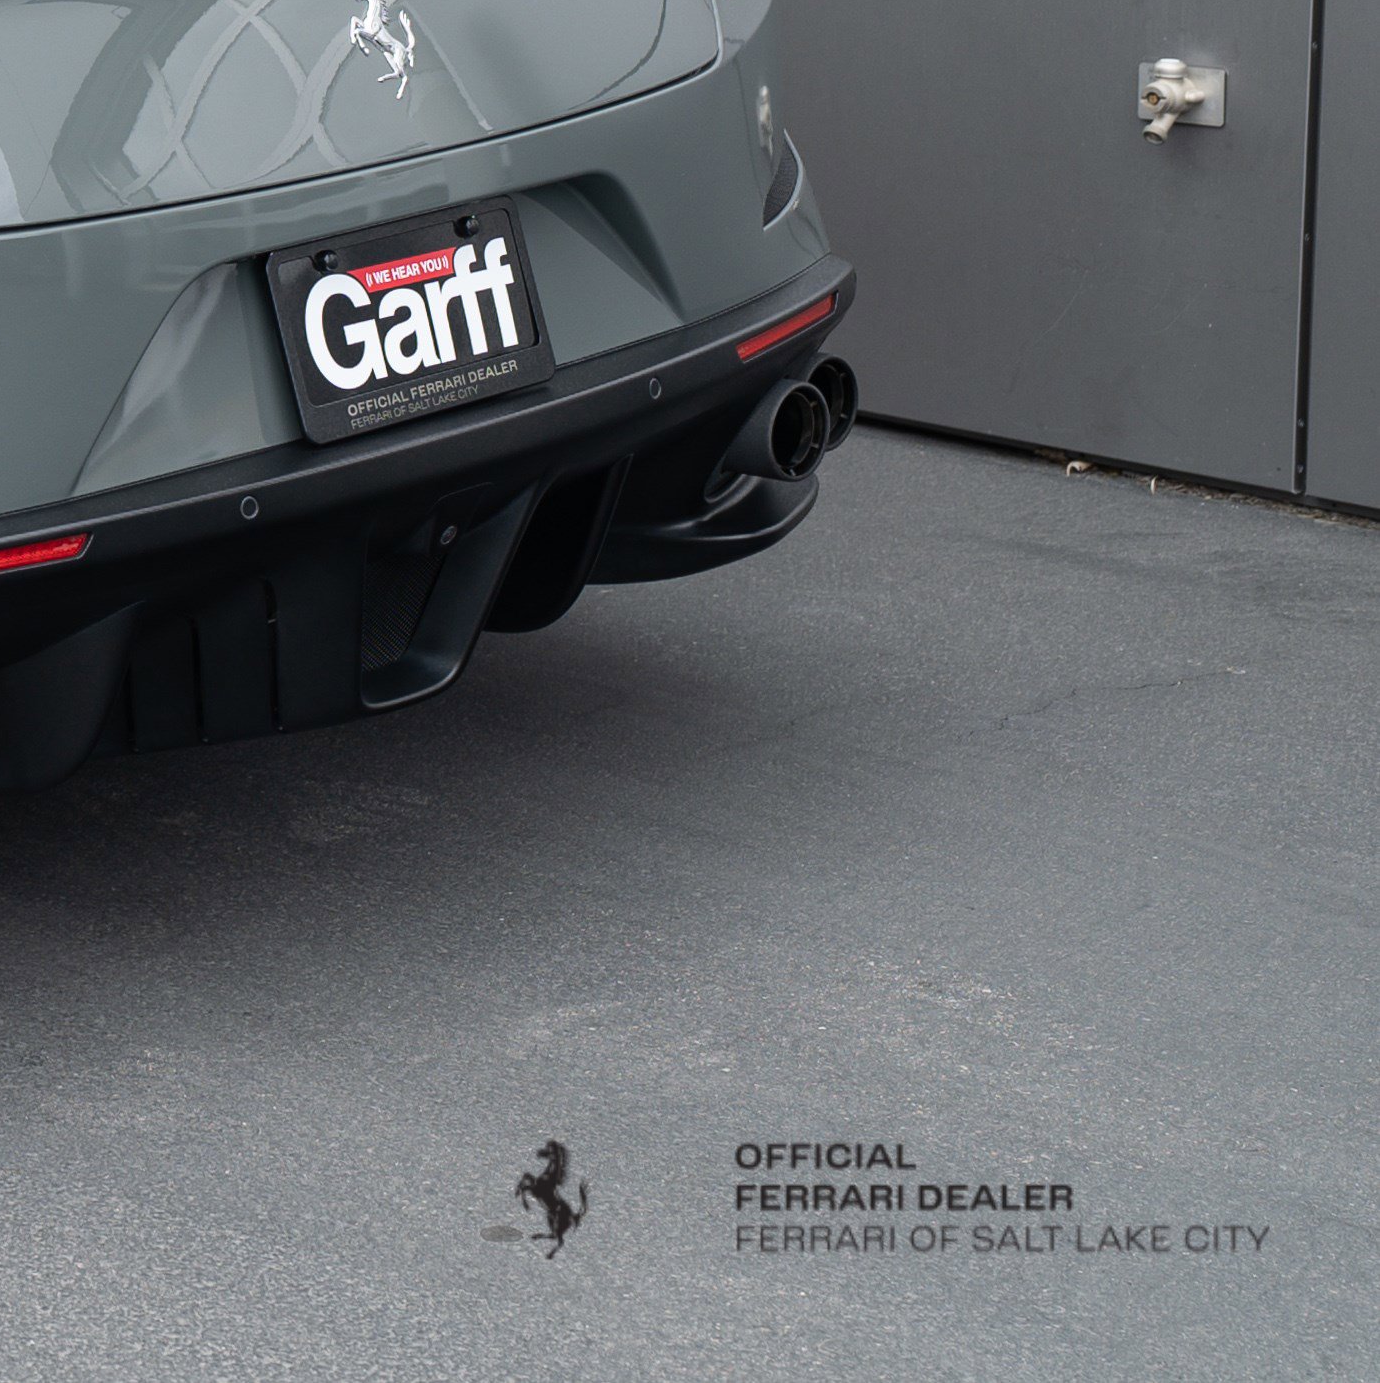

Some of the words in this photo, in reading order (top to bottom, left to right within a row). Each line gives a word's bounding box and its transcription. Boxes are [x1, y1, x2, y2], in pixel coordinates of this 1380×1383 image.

[372, 269, 391, 285] WE
[391, 262, 421, 281] HEAR
[420, 257, 442, 274] YOU
[304, 237, 519, 390] Garff
[347, 391, 409, 417] OFFICIAL
[410, 375, 466, 399] FERRARI
[468, 359, 518, 383] DEALER
[350, 411, 392, 430] FERRARI
[393, 407, 408, 418] OF
[409, 398, 430, 414] SALT
[432, 392, 457, 406] LAKE
[457, 385, 479, 400] CITY
